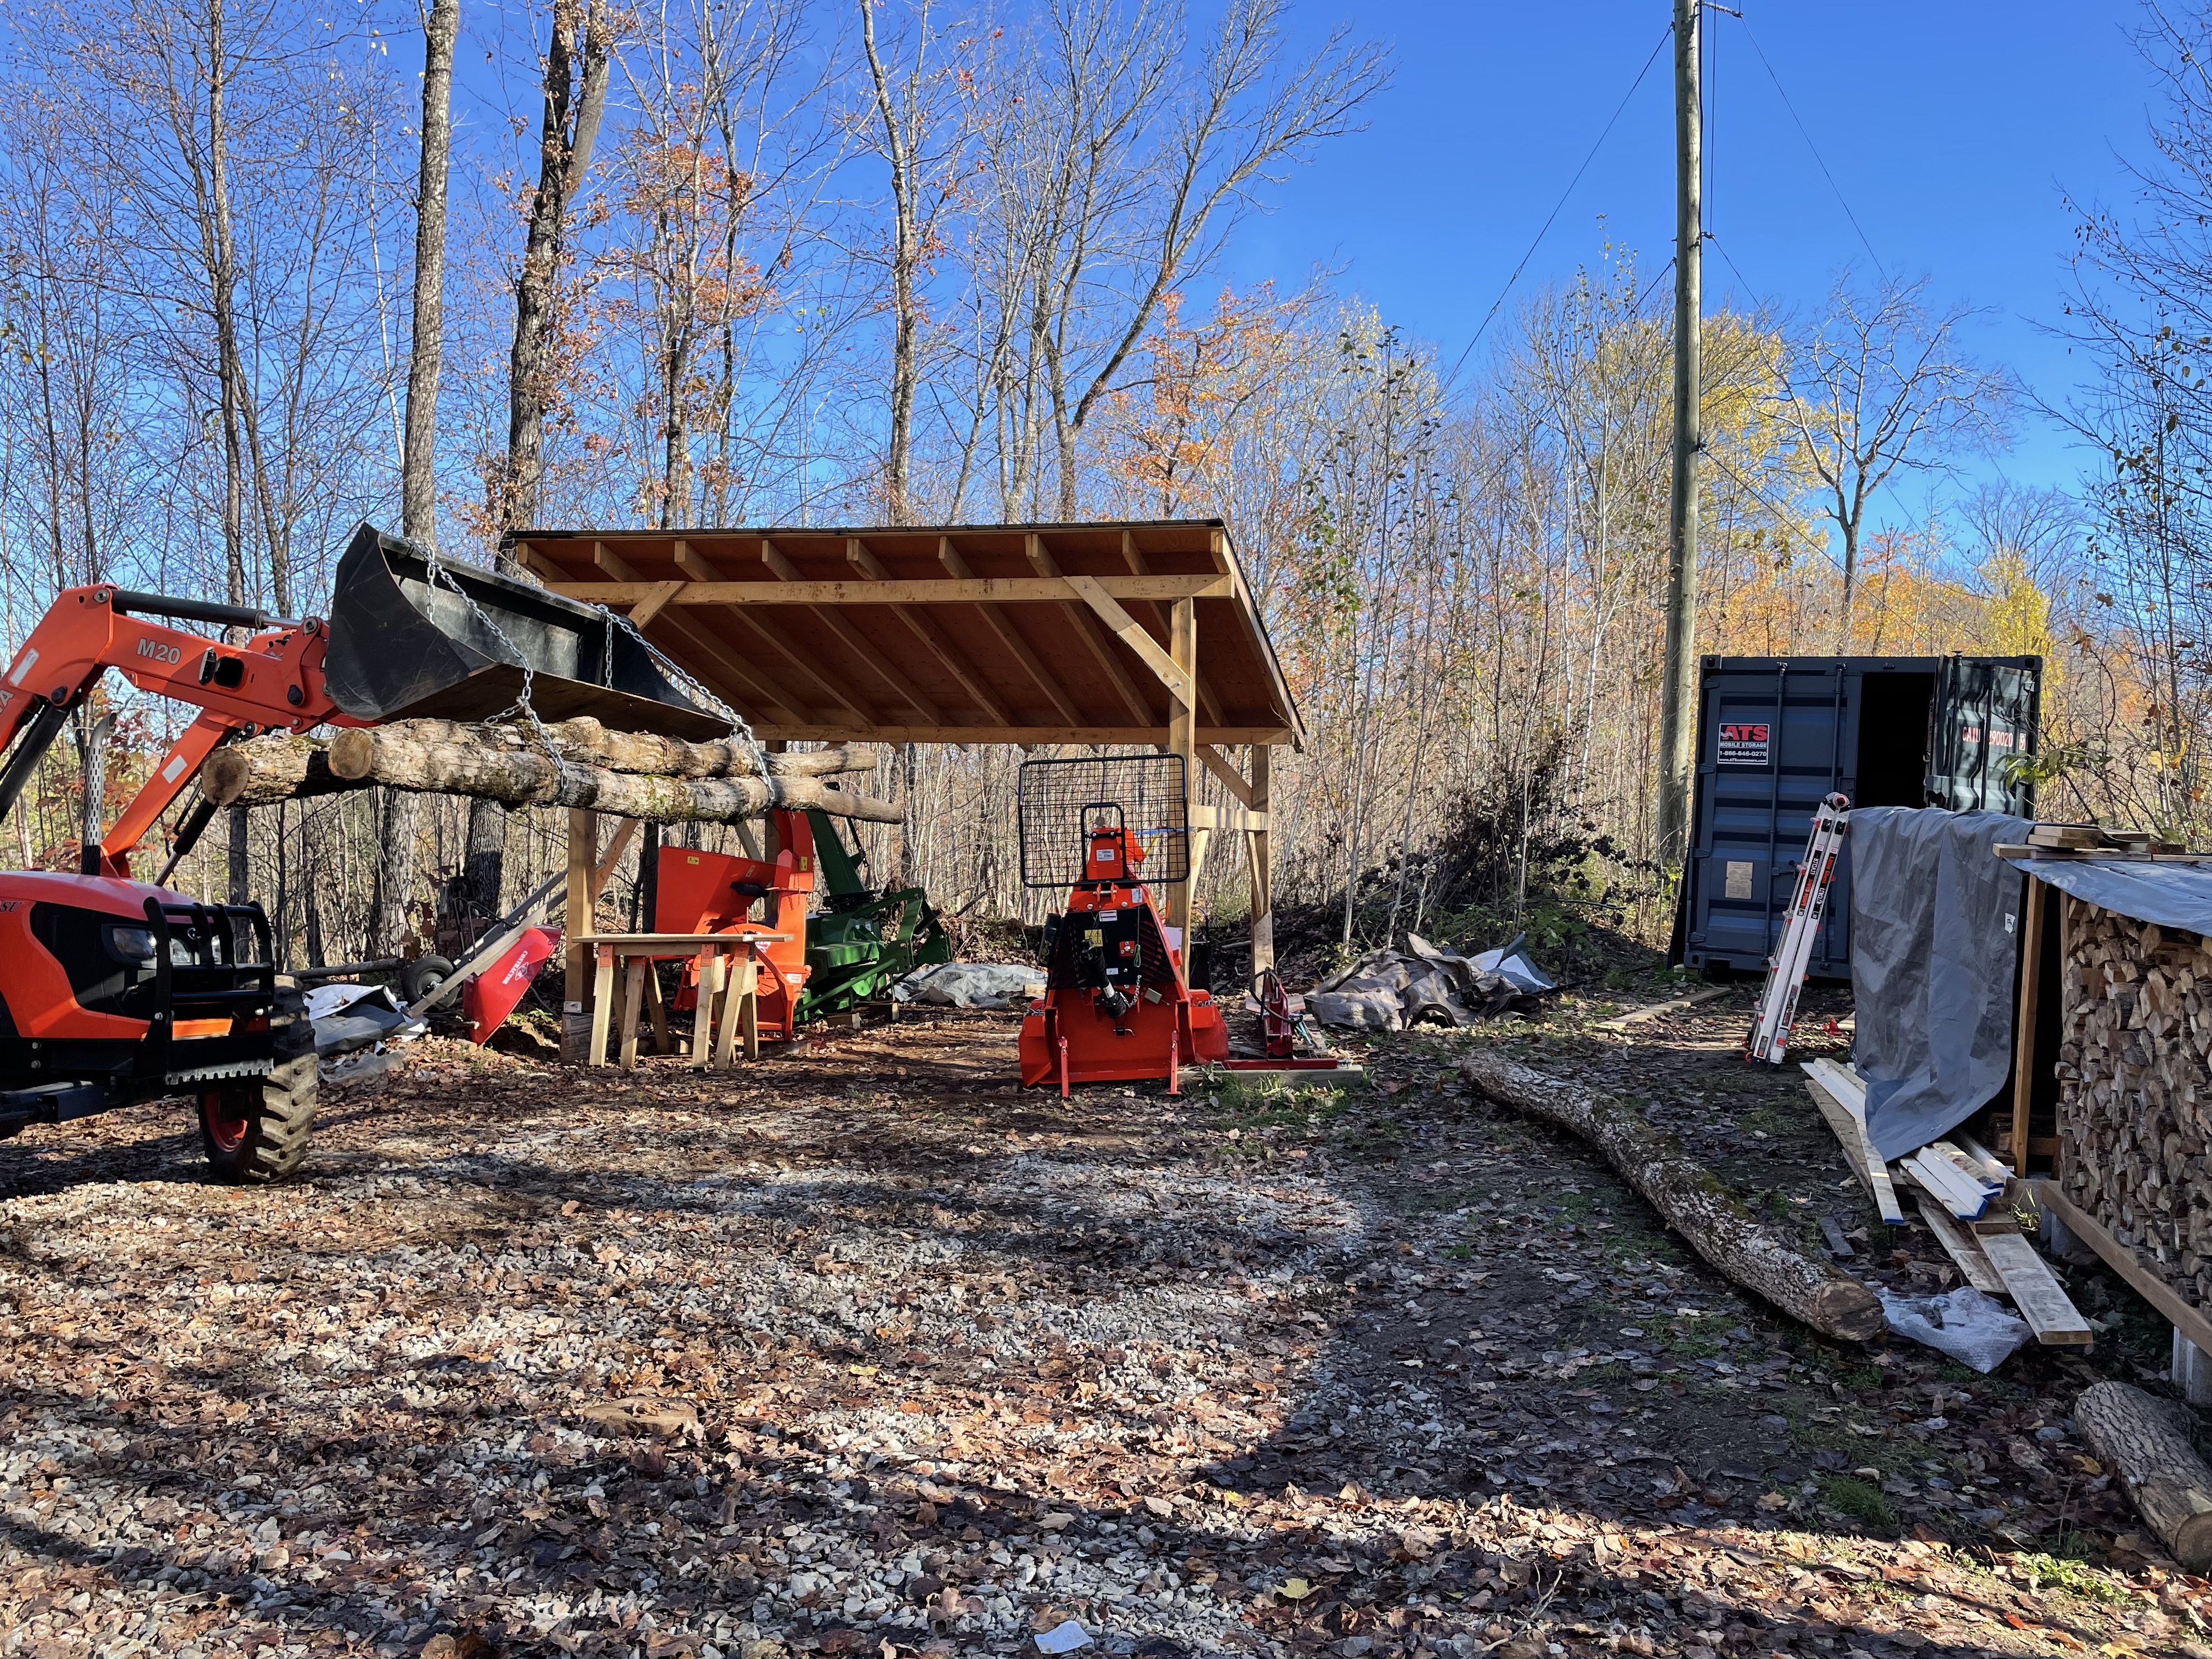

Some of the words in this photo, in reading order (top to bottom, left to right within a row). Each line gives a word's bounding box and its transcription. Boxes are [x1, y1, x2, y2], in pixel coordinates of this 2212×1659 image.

[137, 637, 181, 665] M20
[1722, 726, 1767, 741] ATS
[502, 950, 528, 985] CONTRACTOR
